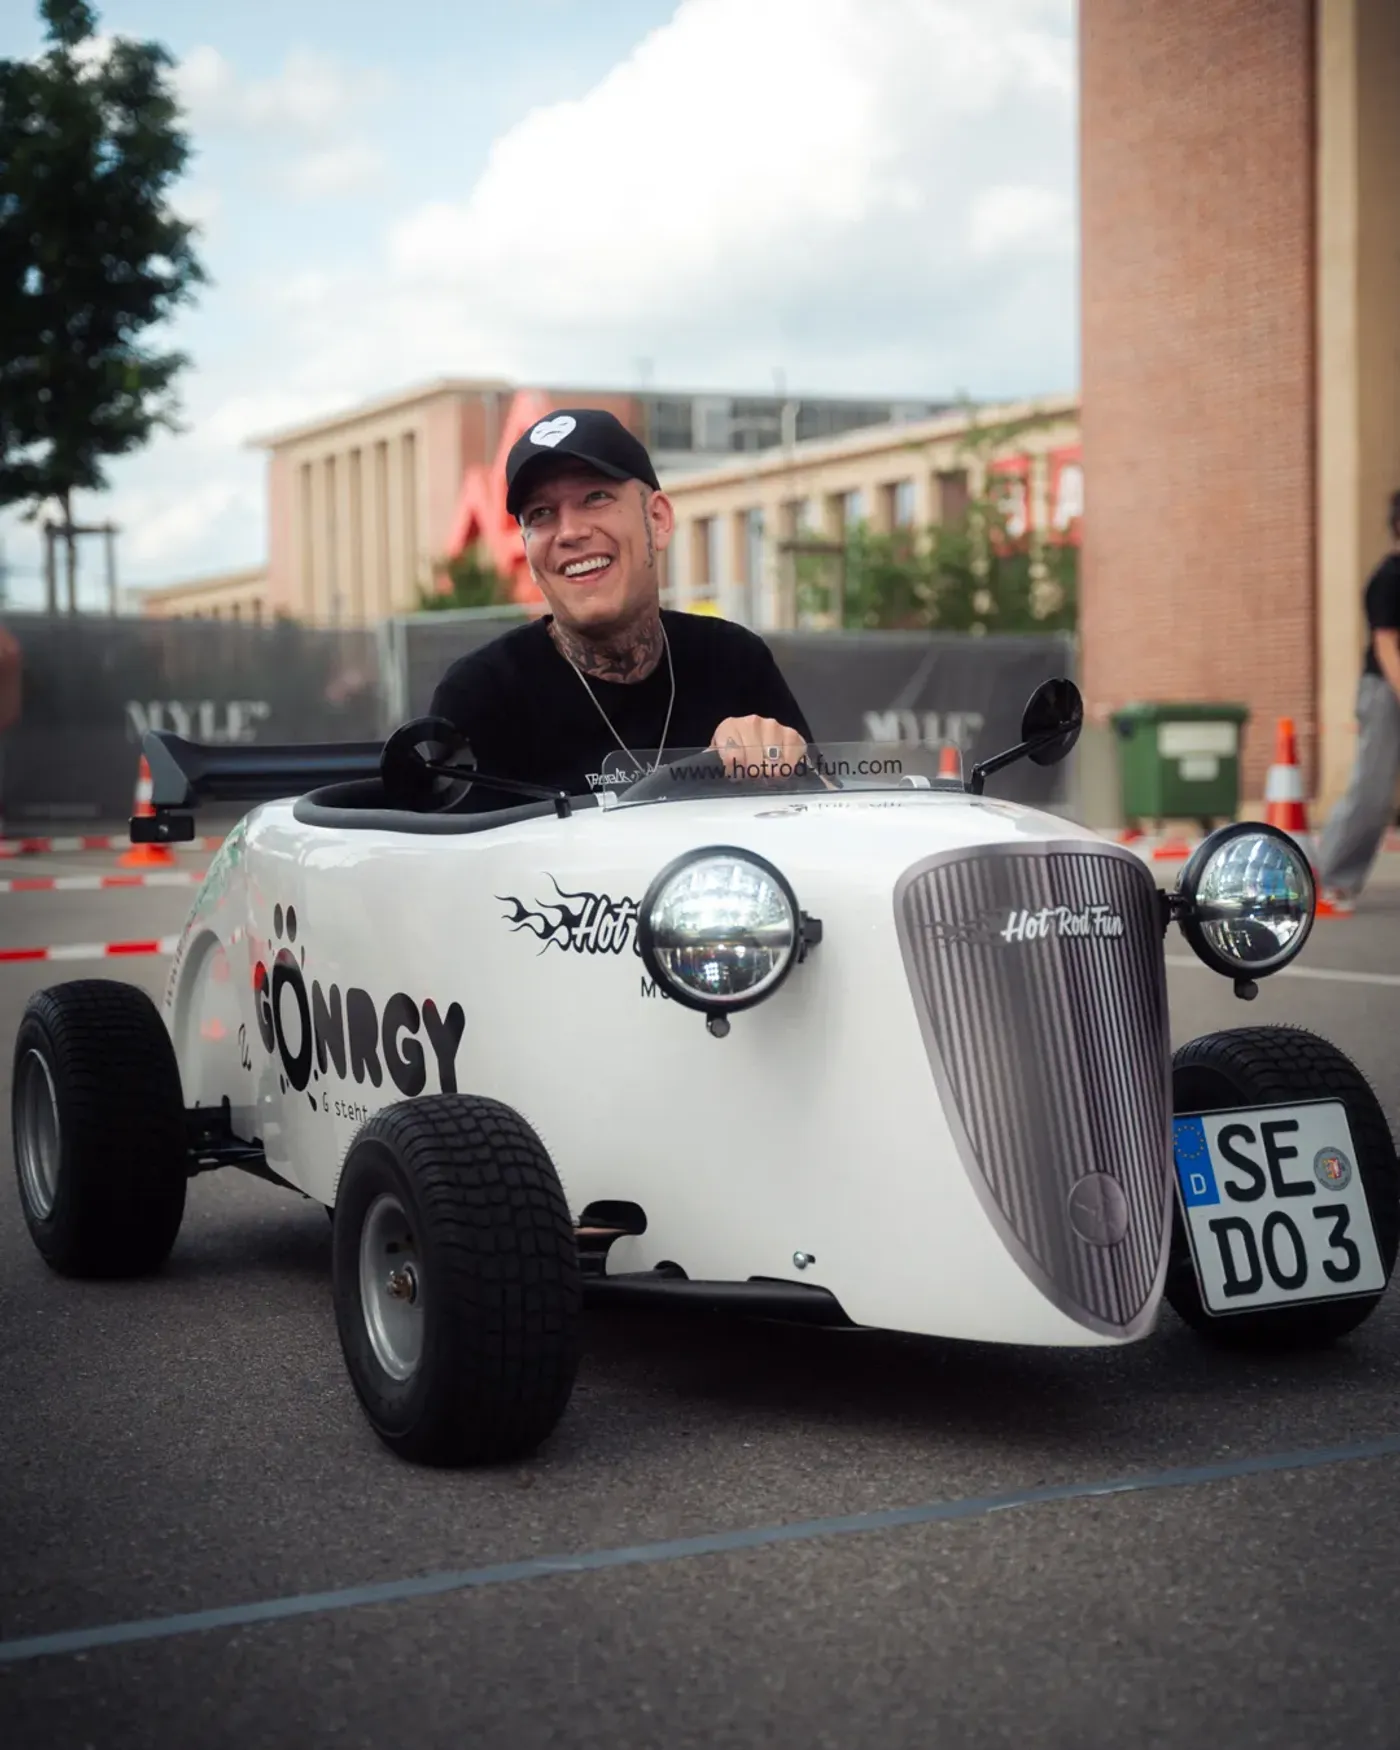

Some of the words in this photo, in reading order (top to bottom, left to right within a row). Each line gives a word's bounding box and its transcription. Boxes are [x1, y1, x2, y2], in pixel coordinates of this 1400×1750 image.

[669, 754, 902, 780] www.hotrod-fun.com
[1000, 907, 1055, 942] Hot
[1055, 905, 1091, 936] Rod
[1090, 905, 1124, 936] Fun
[254, 903, 466, 1097] GÖNRGY
[334, 1099, 368, 1124] steht
[1217, 1119, 1316, 1203] SE
[1190, 1173, 1207, 1195] D
[1208, 1210, 1308, 1298] DO
[1312, 1203, 1361, 1283] 3
